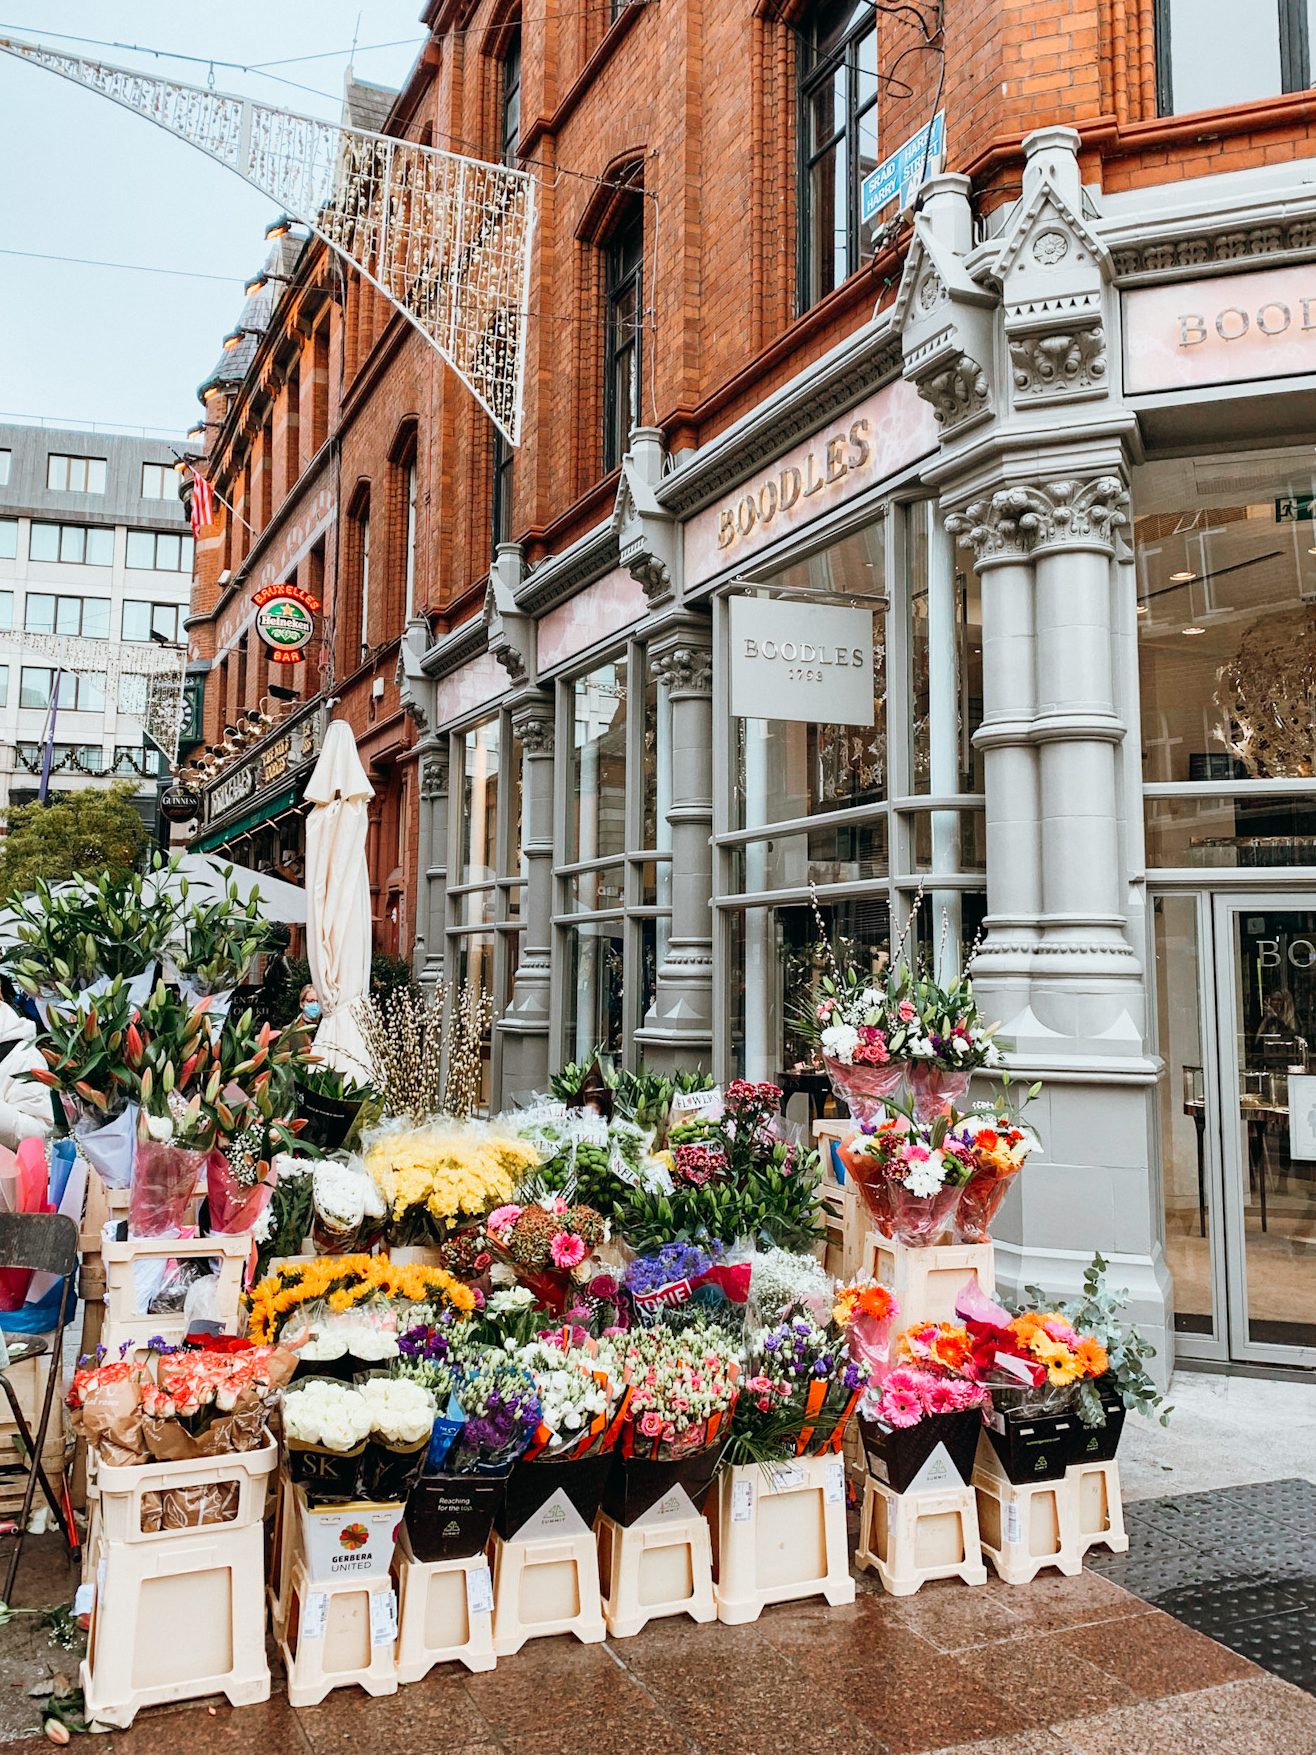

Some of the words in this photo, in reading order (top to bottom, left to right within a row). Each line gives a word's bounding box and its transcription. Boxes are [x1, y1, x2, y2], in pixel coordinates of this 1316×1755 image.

[903, 139, 939, 180] STREET
[866, 177, 897, 212] HARRY
[717, 418, 872, 550] BOODLES
[254, 585, 320, 611] BRUXELLES
[260, 615, 310, 631] Heineken
[273, 650, 299, 662] BAR
[743, 638, 865, 668] BOODLES
[162, 796, 198, 806] GUINNESS
[302, 1453, 339, 1477] SK
[437, 1504, 448, 1512] for
[439, 1497, 471, 1506] Reaching
[331, 1553, 373, 1563] GERBERA
[331, 1561, 372, 1572] UNITED
